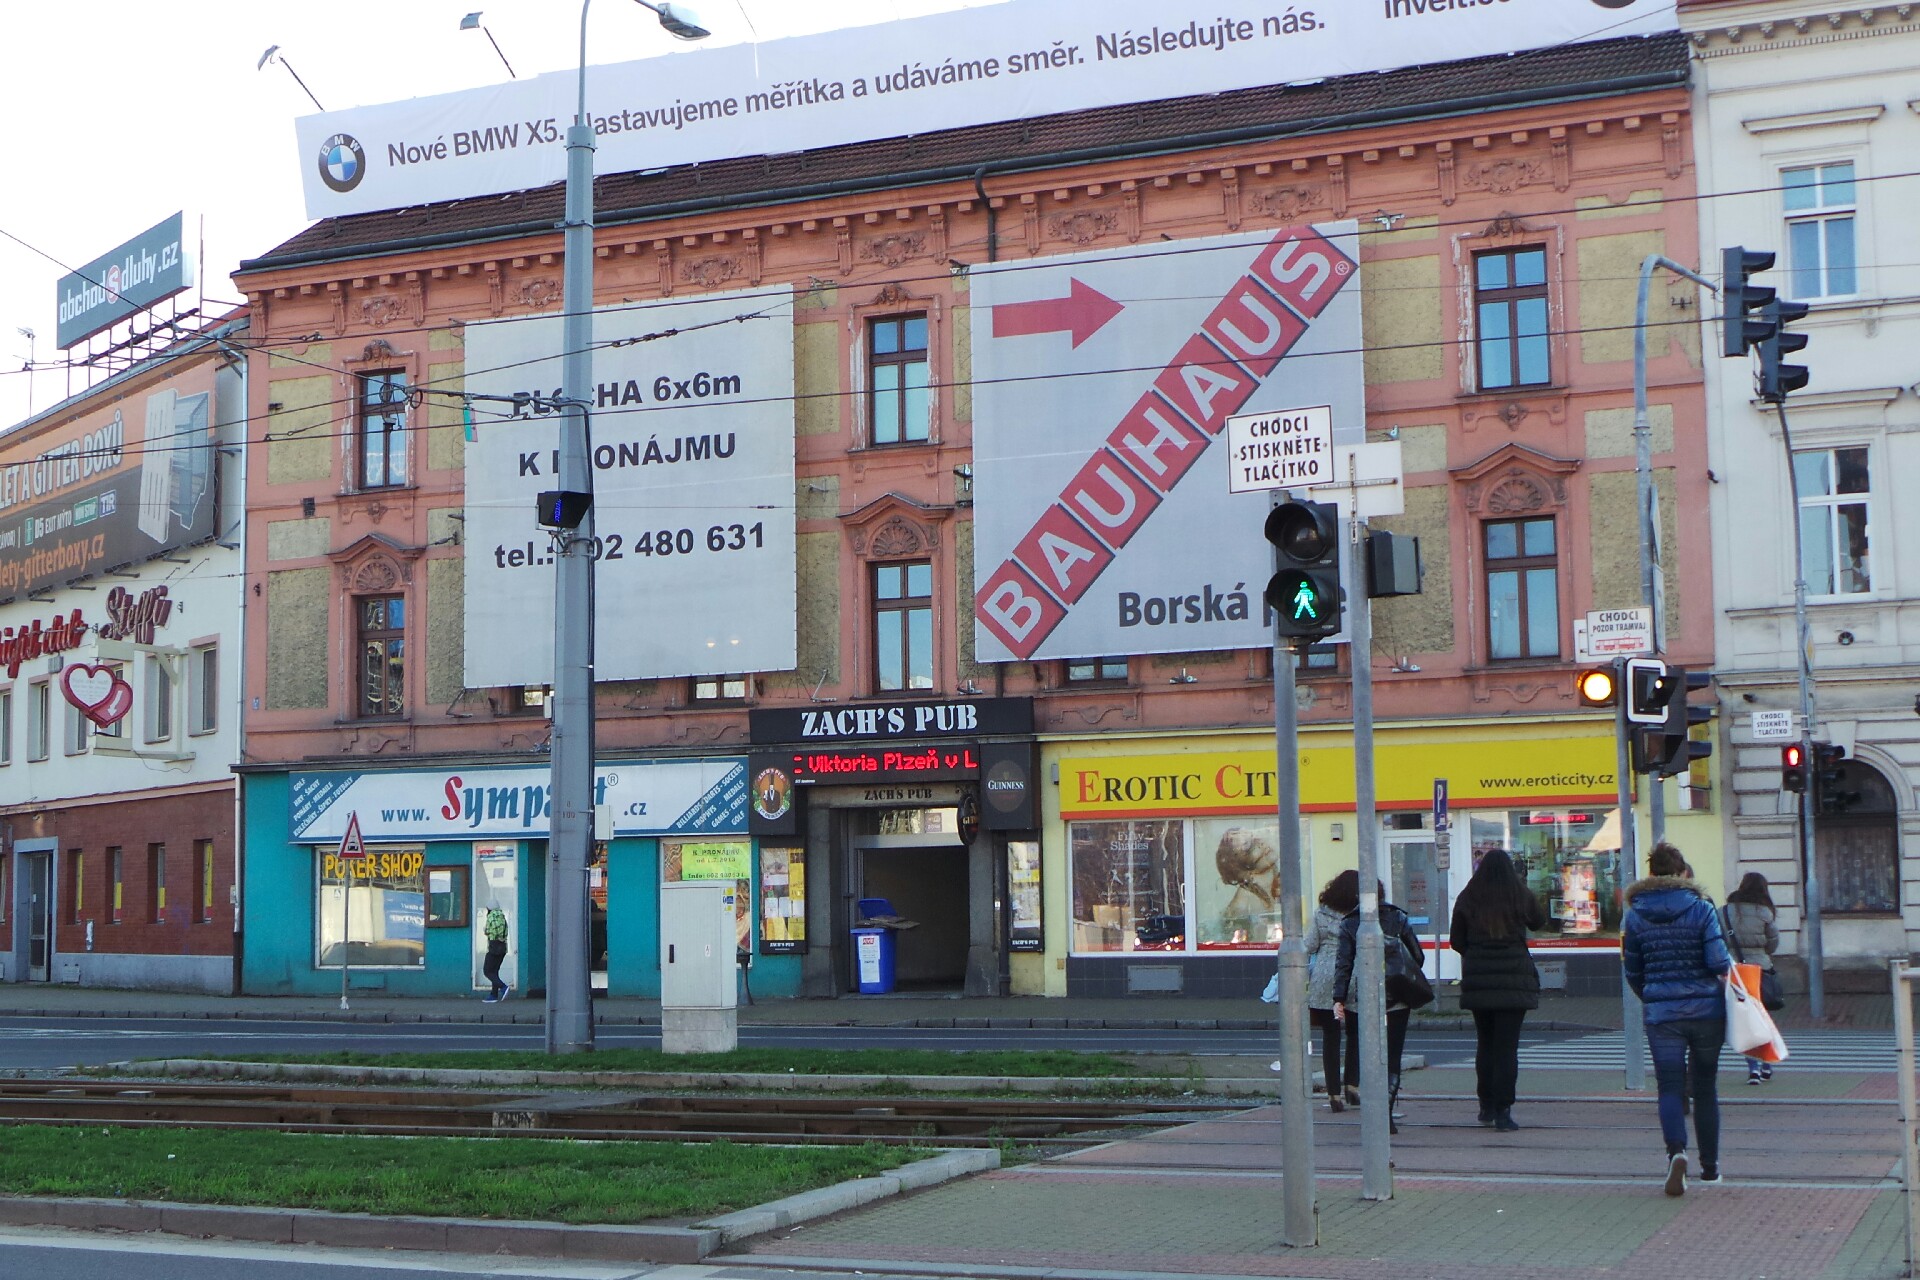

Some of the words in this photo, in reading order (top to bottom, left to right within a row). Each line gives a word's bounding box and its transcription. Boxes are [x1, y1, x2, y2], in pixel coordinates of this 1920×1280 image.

[388, 136, 447, 166] Nové
[453, 124, 518, 156] BMW
[525, 118, 564, 145] X5.
[746, 80, 845, 113] měřítka
[852, 77, 868, 98] a
[875, 57, 1000, 93] udáváme
[1008, 41, 1085, 74] směr.
[1096, 17, 1254, 61] Následujte
[1263, 6, 1325, 37] nás.
[321, 134, 360, 155] BMW
[653, 372, 741, 402] 6x6m
[982, 235, 1332, 645] BAUHAUS
[1250, 416, 1308, 437] CHODCI
[33, 439, 80, 496] GITTER
[83, 409, 124, 478] BOXŮ
[519, 451, 540, 477] K
[553, 433, 736, 474] ONÁJMU
[1240, 435, 1321, 461] STISKNĚTE
[1244, 459, 1318, 483] TLAČÍTKO
[101, 493, 115, 514] TIR
[45, 514, 56, 534] EXIT
[634, 528, 694, 557] 480
[706, 522, 763, 553] 631
[1118, 582, 1249, 628] Borská
[1599, 611, 1639, 622] CHODCI
[1592, 625, 1614, 633] POZOR
[1616, 622, 1646, 632] TRAMVAJ
[0, 620, 42, 678] ight
[801, 706, 906, 737] ZACH'S
[915, 704, 978, 732] PUB
[721, 763, 744, 787] SOCCERS
[808, 753, 878, 774] Viktoria
[883, 749, 939, 773] Plzeň
[944, 755, 958, 769] v
[293, 777, 307, 792] GOLF
[907, 788, 932, 799] PUB
[987, 780, 1024, 790] GUINNESS
[1214, 764, 1277, 800] CIT
[1479, 773, 1614, 790] www.eroticcity.cz
[381, 809, 430, 822] www.
[441, 776, 608, 829] Sympt
[692, 804, 717, 829] TROPHYS
[723, 779, 745, 802] MEDALS
[711, 809, 730, 828] GAMES
[730, 792, 747, 810] CHESS
[1437, 784, 1443, 813] P
[731, 810, 745, 826] GOLF
[324, 854, 377, 880] POKER
[381, 852, 422, 878] SHOP
